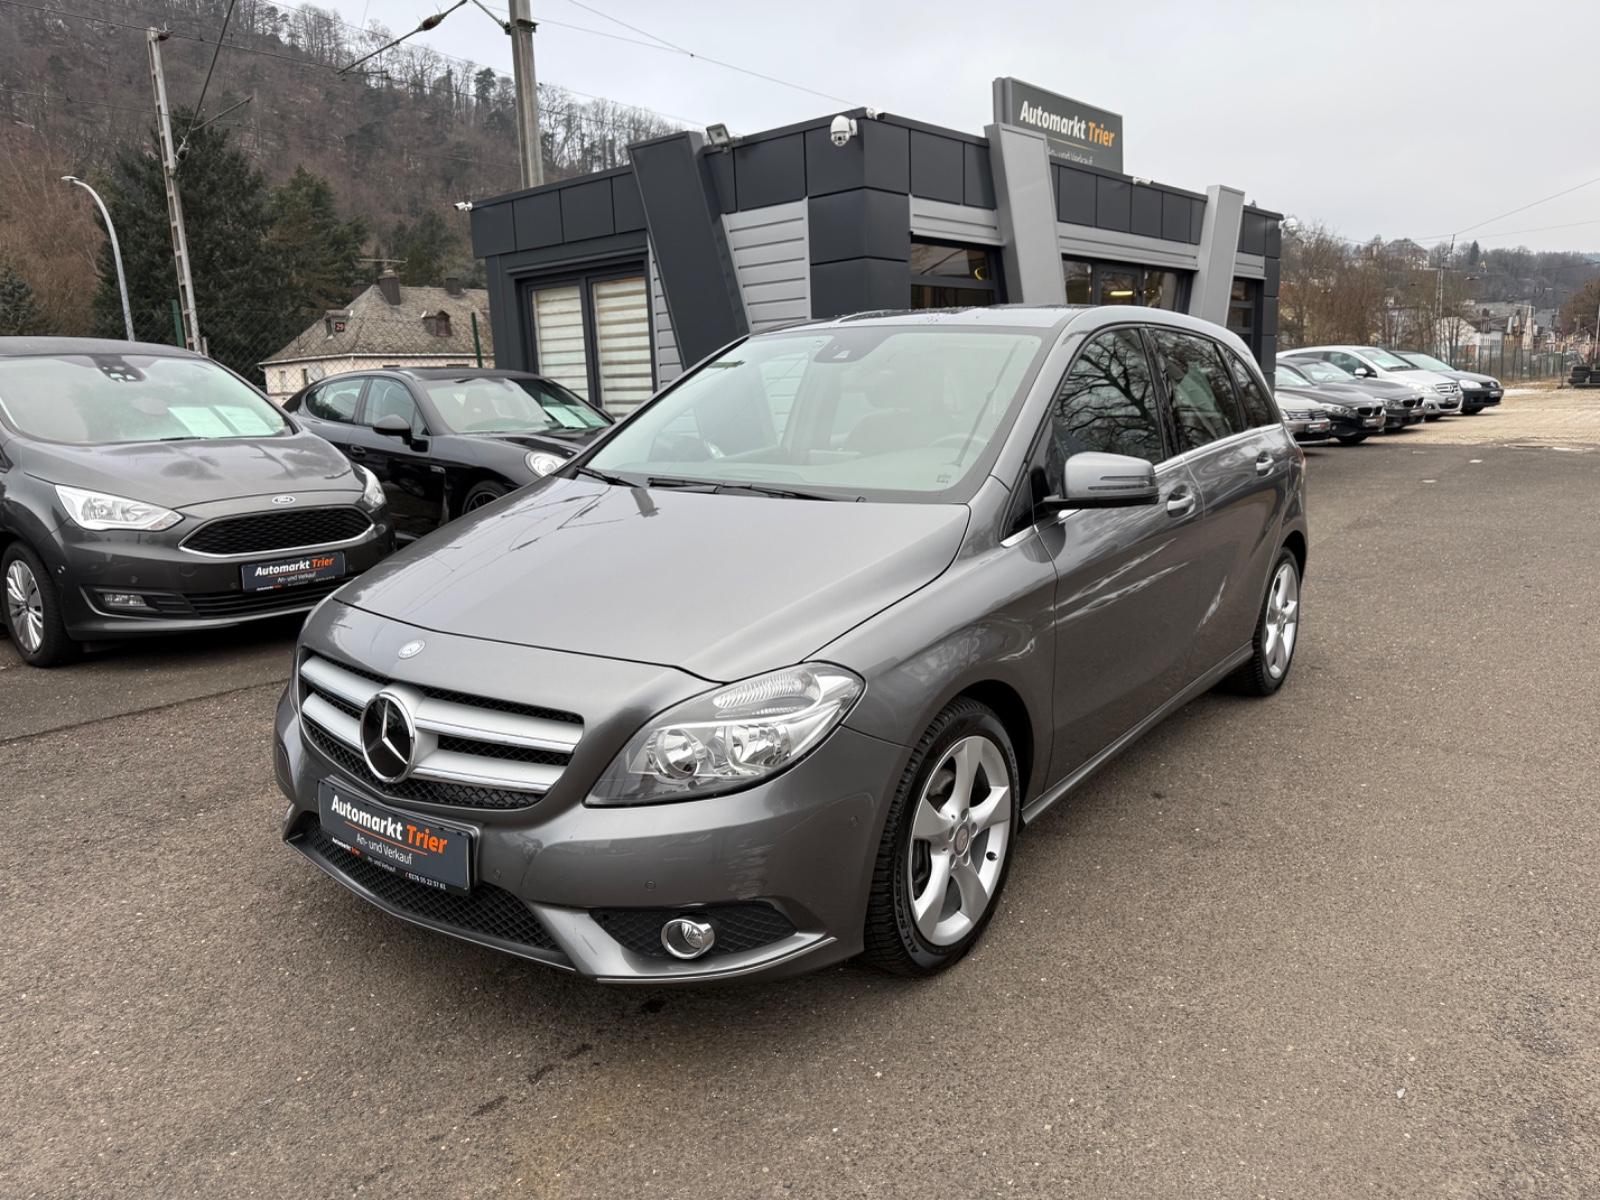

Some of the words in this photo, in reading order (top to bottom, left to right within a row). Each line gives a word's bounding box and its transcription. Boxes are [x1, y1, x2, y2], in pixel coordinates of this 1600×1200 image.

[1020, 101, 1086, 139] Automarkt
[1088, 122, 1115, 147] Trier
[255, 561, 309, 576] Automarkt
[311, 557, 335, 568] Trier
[331, 795, 403, 841] Automarkt
[406, 825, 448, 854] Trier
[356, 833, 367, 846] An-
[368, 840, 382, 854] und
[382, 843, 412, 865] Verkauf
